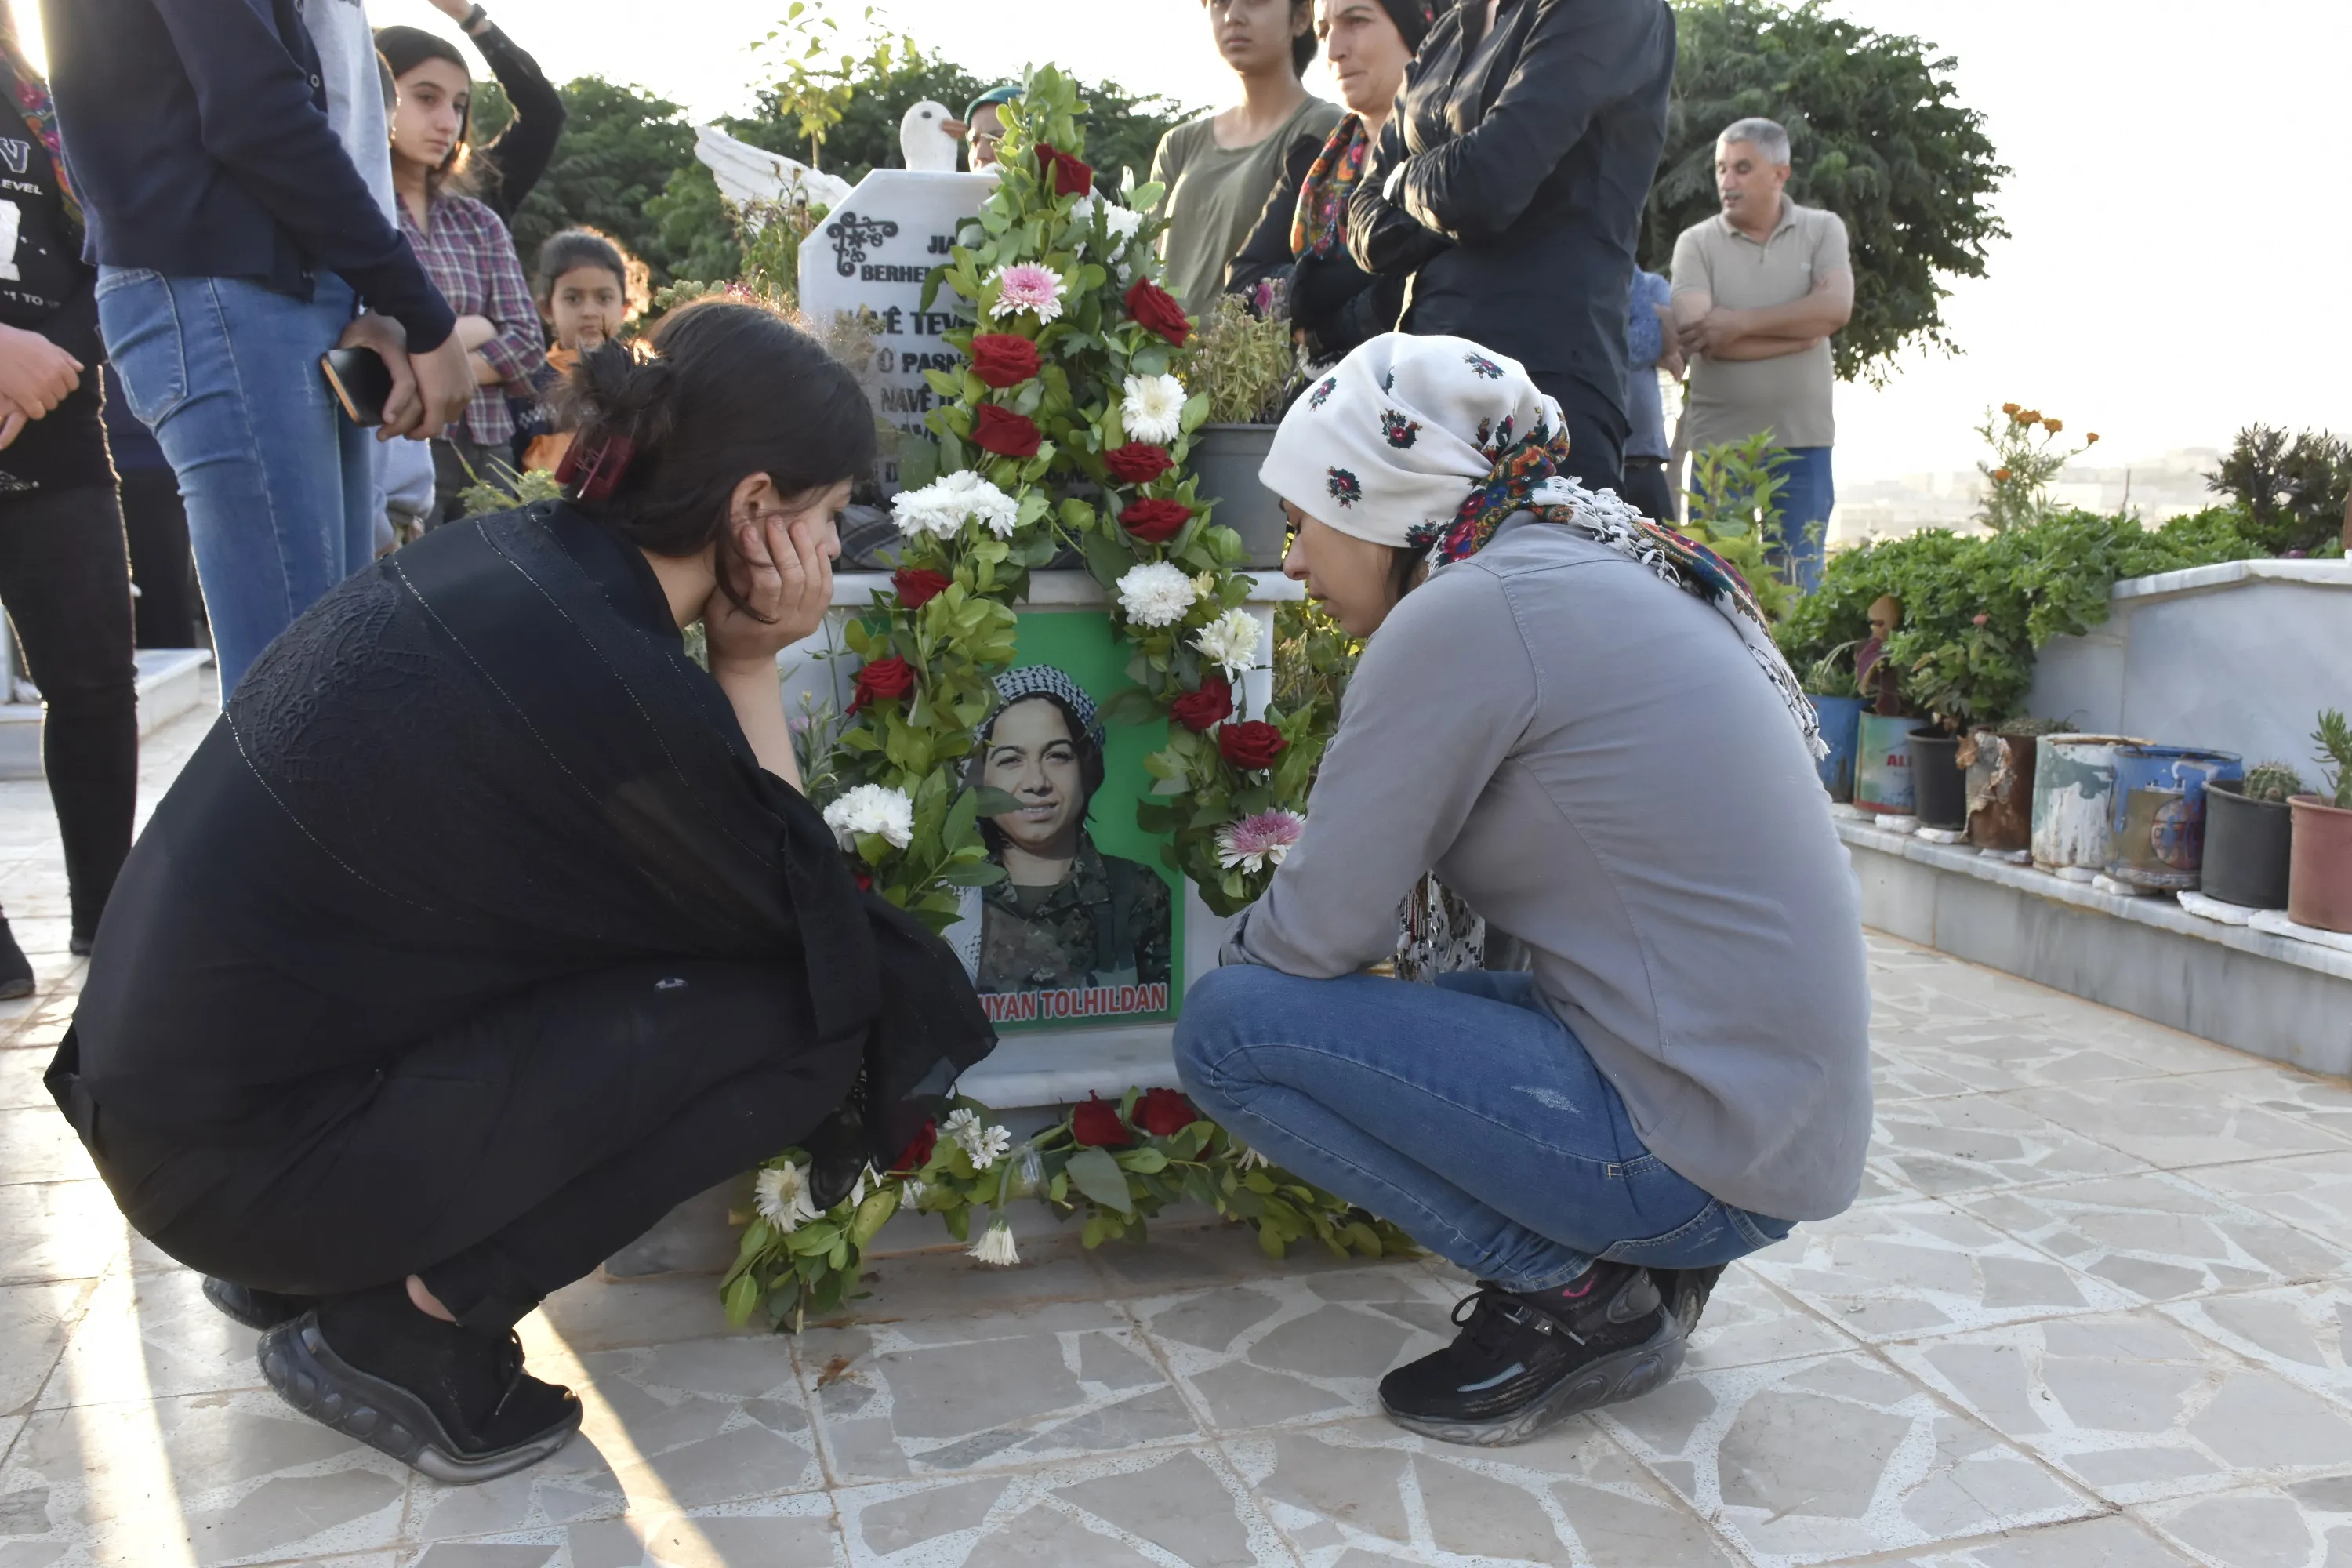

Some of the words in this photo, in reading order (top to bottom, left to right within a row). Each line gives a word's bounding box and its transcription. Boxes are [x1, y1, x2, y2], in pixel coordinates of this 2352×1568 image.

[0, 179, 43, 195] EVEL
[861, 264, 933, 283] BERHE
[978, 993, 1036, 1021] IYAN
[1040, 984, 1167, 1018] TOLHILDAN
